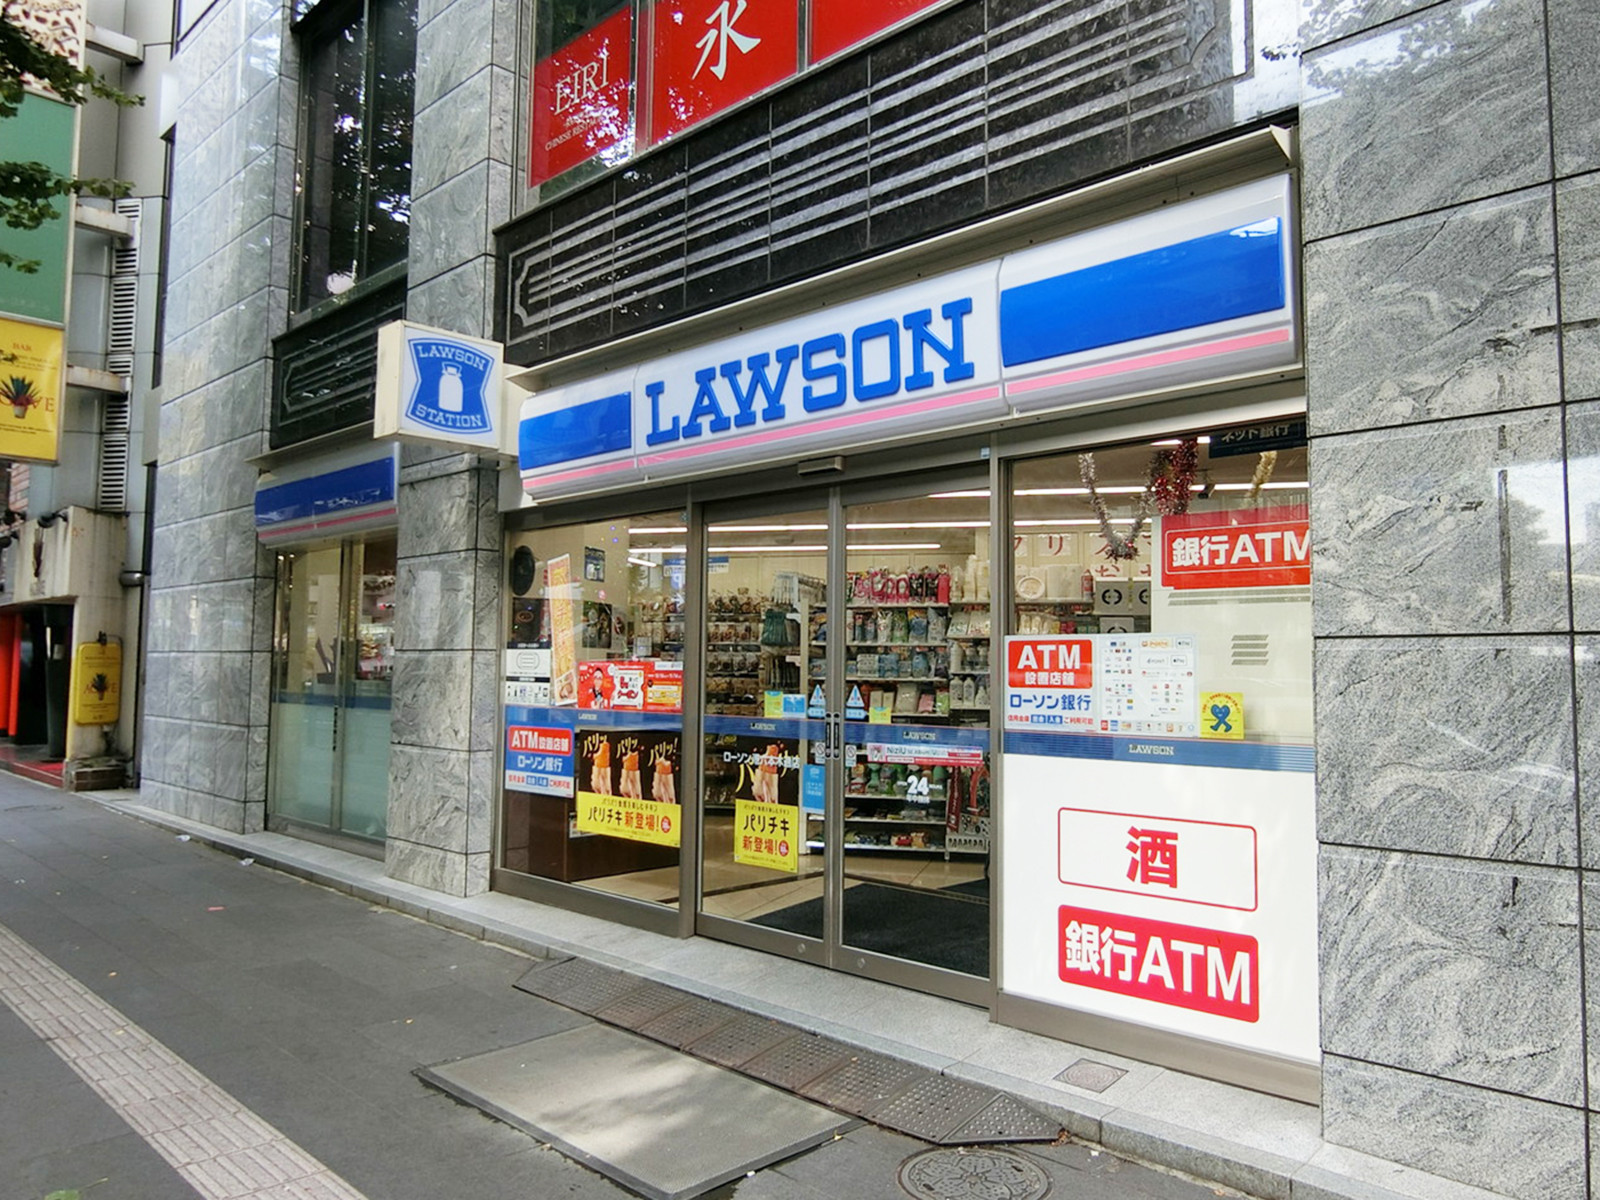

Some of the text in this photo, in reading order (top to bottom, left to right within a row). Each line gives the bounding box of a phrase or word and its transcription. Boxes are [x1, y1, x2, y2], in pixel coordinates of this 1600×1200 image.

[417, 345, 486, 371] LAWSON
[646, 297, 974, 446] LAWSON
[415, 403, 483, 427] STATION
[1172, 529, 1310, 567] 銀行ATM
[1017, 644, 1080, 670] ATM
[1025, 671, 1075, 685] 設置店舗
[1010, 694, 1091, 711] ローソン銀行
[1128, 744, 1175, 756] LAWSON
[517, 755, 563, 772] ローソン銀行
[907, 774, 930, 796] 24
[743, 813, 790, 837] パリチキ
[1126, 826, 1178, 889] 酒
[1065, 920, 1251, 1005] 銀行ATM
